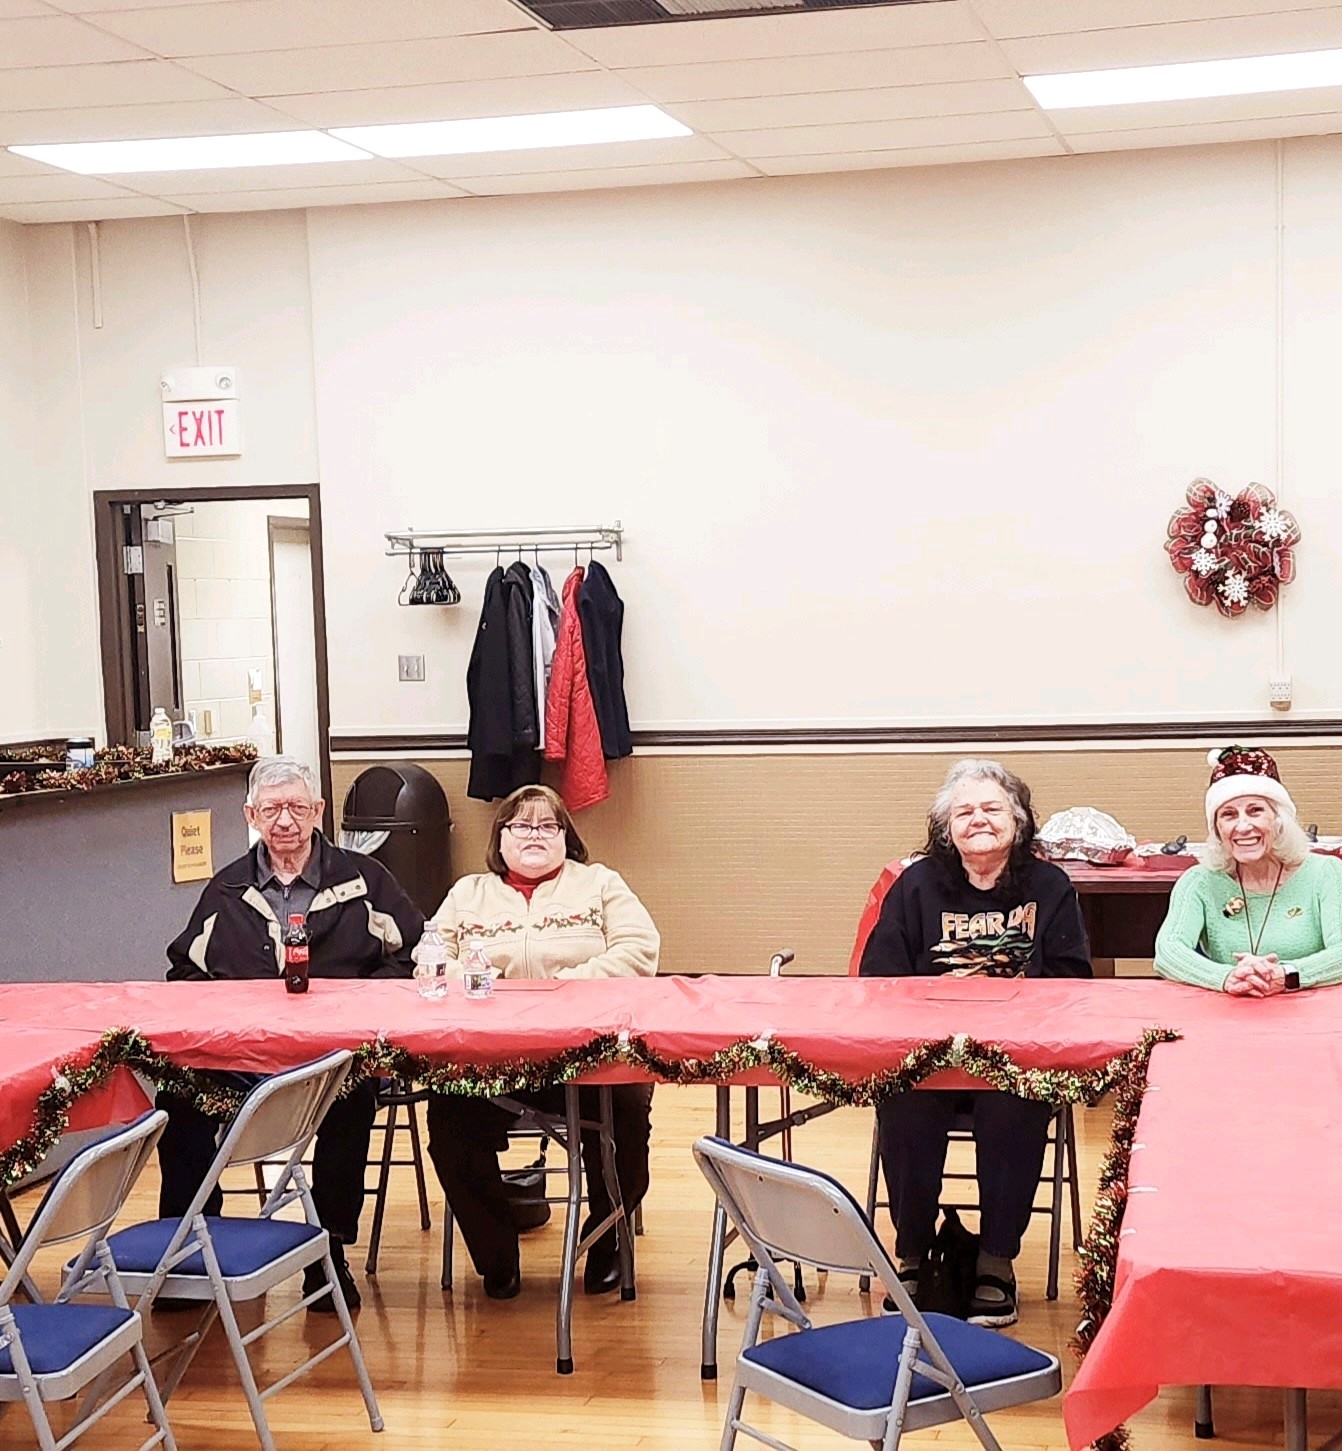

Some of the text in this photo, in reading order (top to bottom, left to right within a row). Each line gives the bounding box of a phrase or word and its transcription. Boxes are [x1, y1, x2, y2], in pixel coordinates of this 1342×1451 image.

[177, 408, 225, 448] EXIT
[181, 825, 201, 838] Quiet
[180, 844, 204, 857] Please
[941, 911, 1006, 941] FEAR
